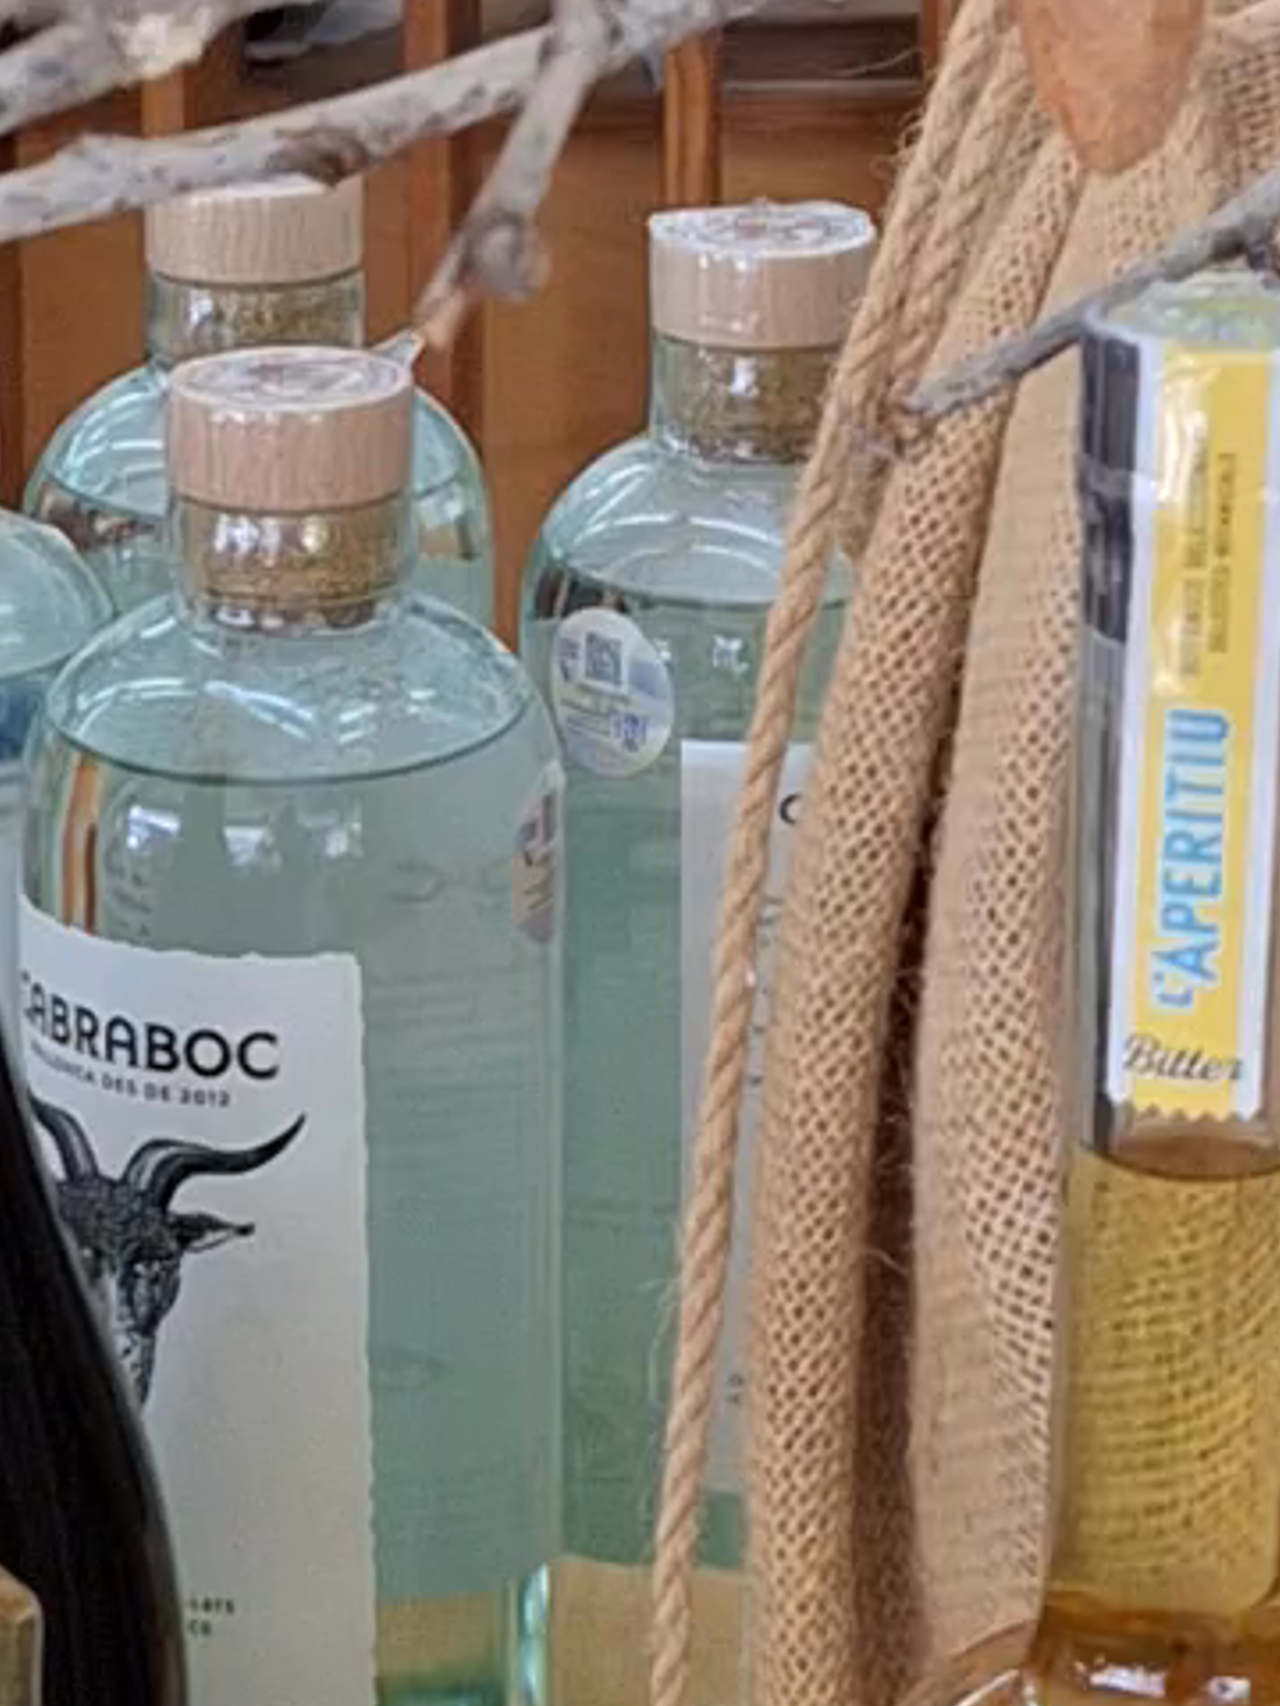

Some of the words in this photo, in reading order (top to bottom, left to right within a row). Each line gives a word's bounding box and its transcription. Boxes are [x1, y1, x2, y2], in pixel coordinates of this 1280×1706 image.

[1153, 707, 1233, 1010] L'APERITIU
[22, 970, 280, 1081] ABRABOC
[1121, 1032, 1244, 1085] Bitter
[143, 1082, 173, 1103] DE
[179, 1087, 233, 1110] 2012
